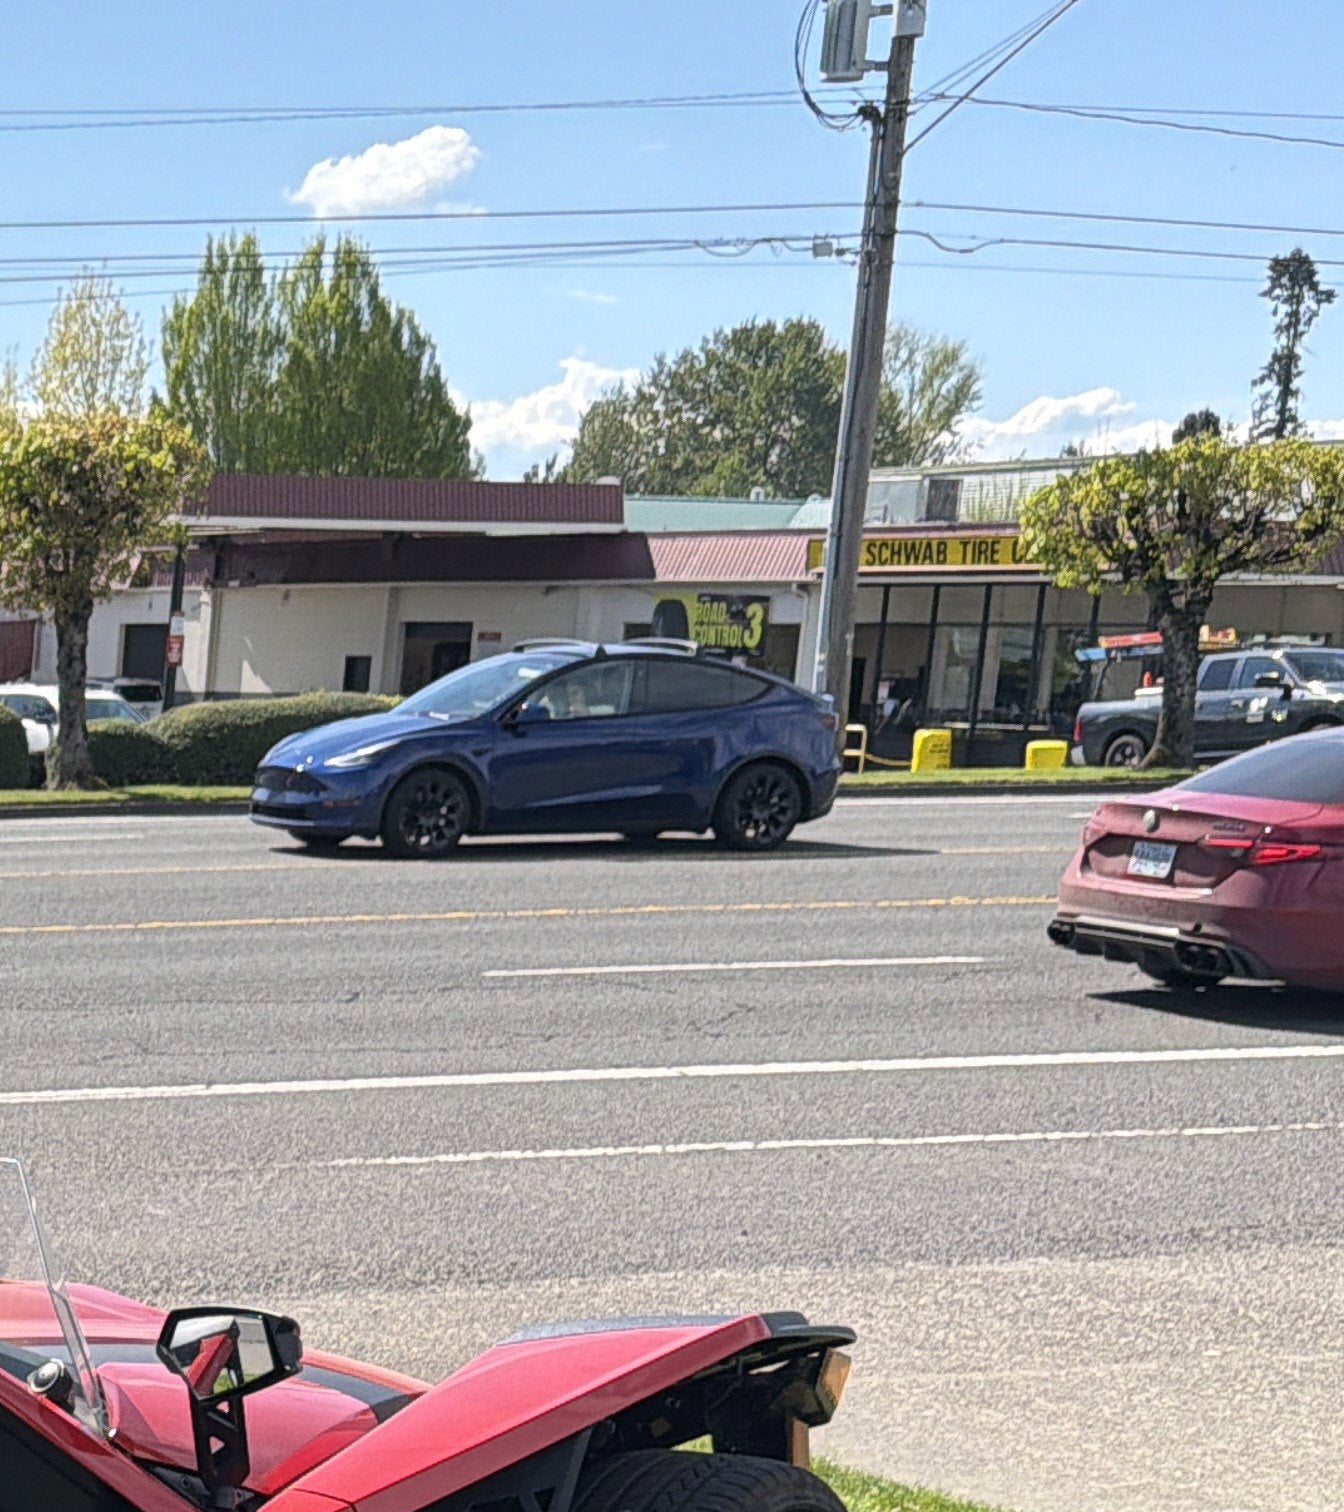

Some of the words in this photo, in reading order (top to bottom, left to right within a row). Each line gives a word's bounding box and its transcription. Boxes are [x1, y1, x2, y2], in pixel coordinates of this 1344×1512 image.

[865, 540, 948, 565] SCHWAB
[959, 539, 1001, 564] TIRE
[695, 601, 727, 623] ROAD
[694, 624, 743, 648] CONTROL
[743, 602, 764, 649] 3
